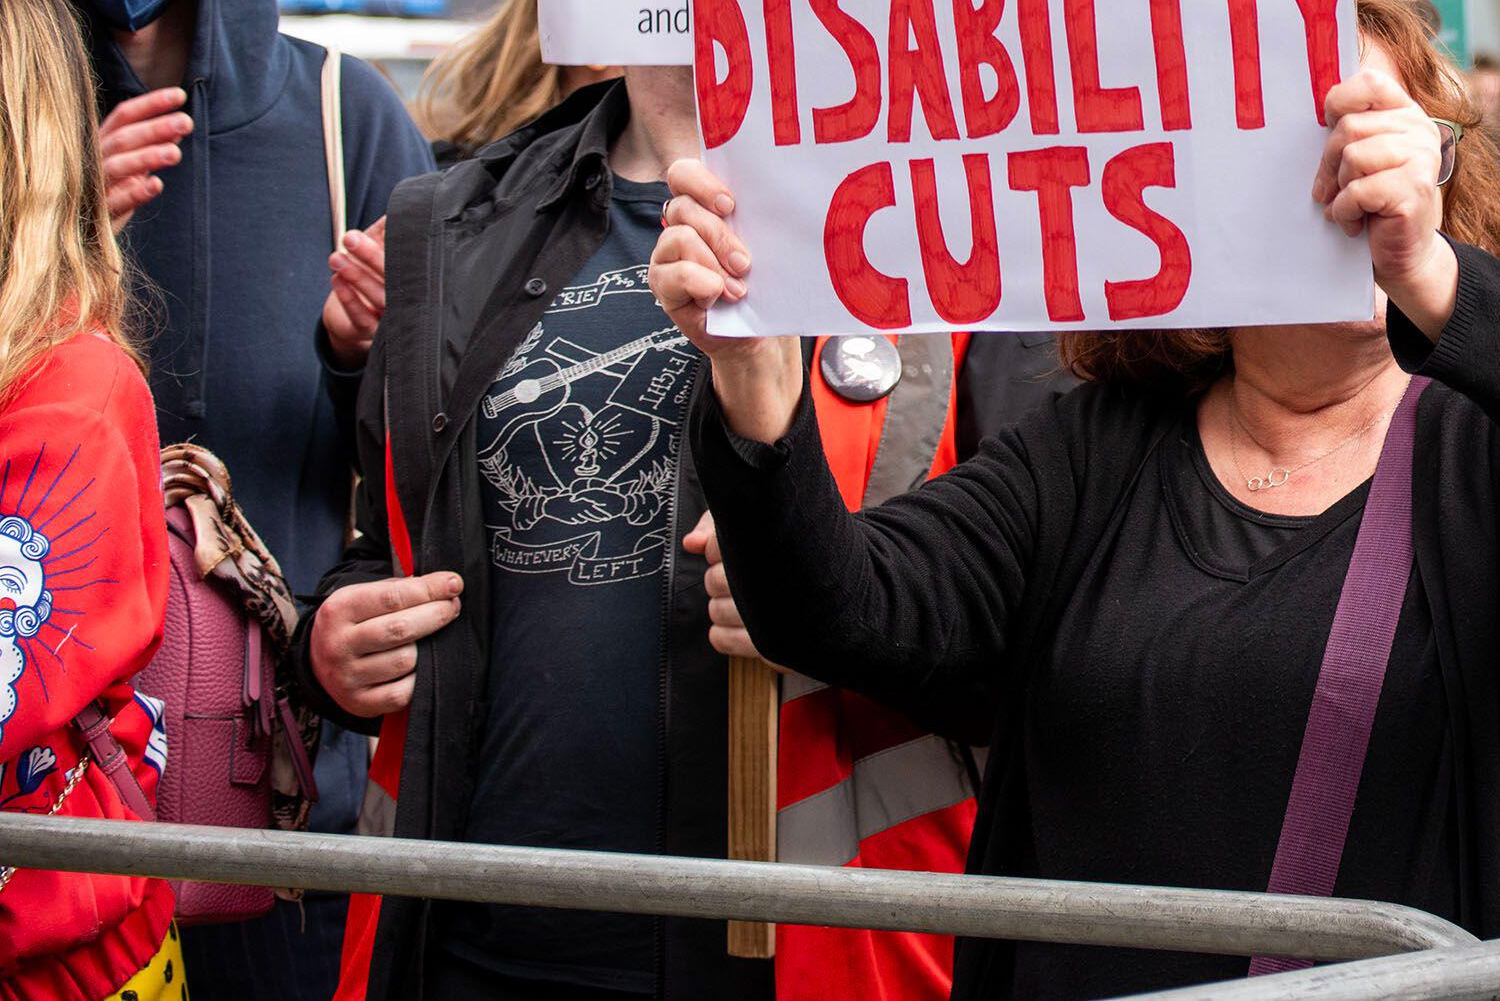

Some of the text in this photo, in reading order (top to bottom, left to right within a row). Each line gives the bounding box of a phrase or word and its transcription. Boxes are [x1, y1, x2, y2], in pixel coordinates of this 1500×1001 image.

[823, 142, 1192, 329] CUTS
[639, 357, 690, 410] FIGHT
[577, 557, 644, 581] LEFT
